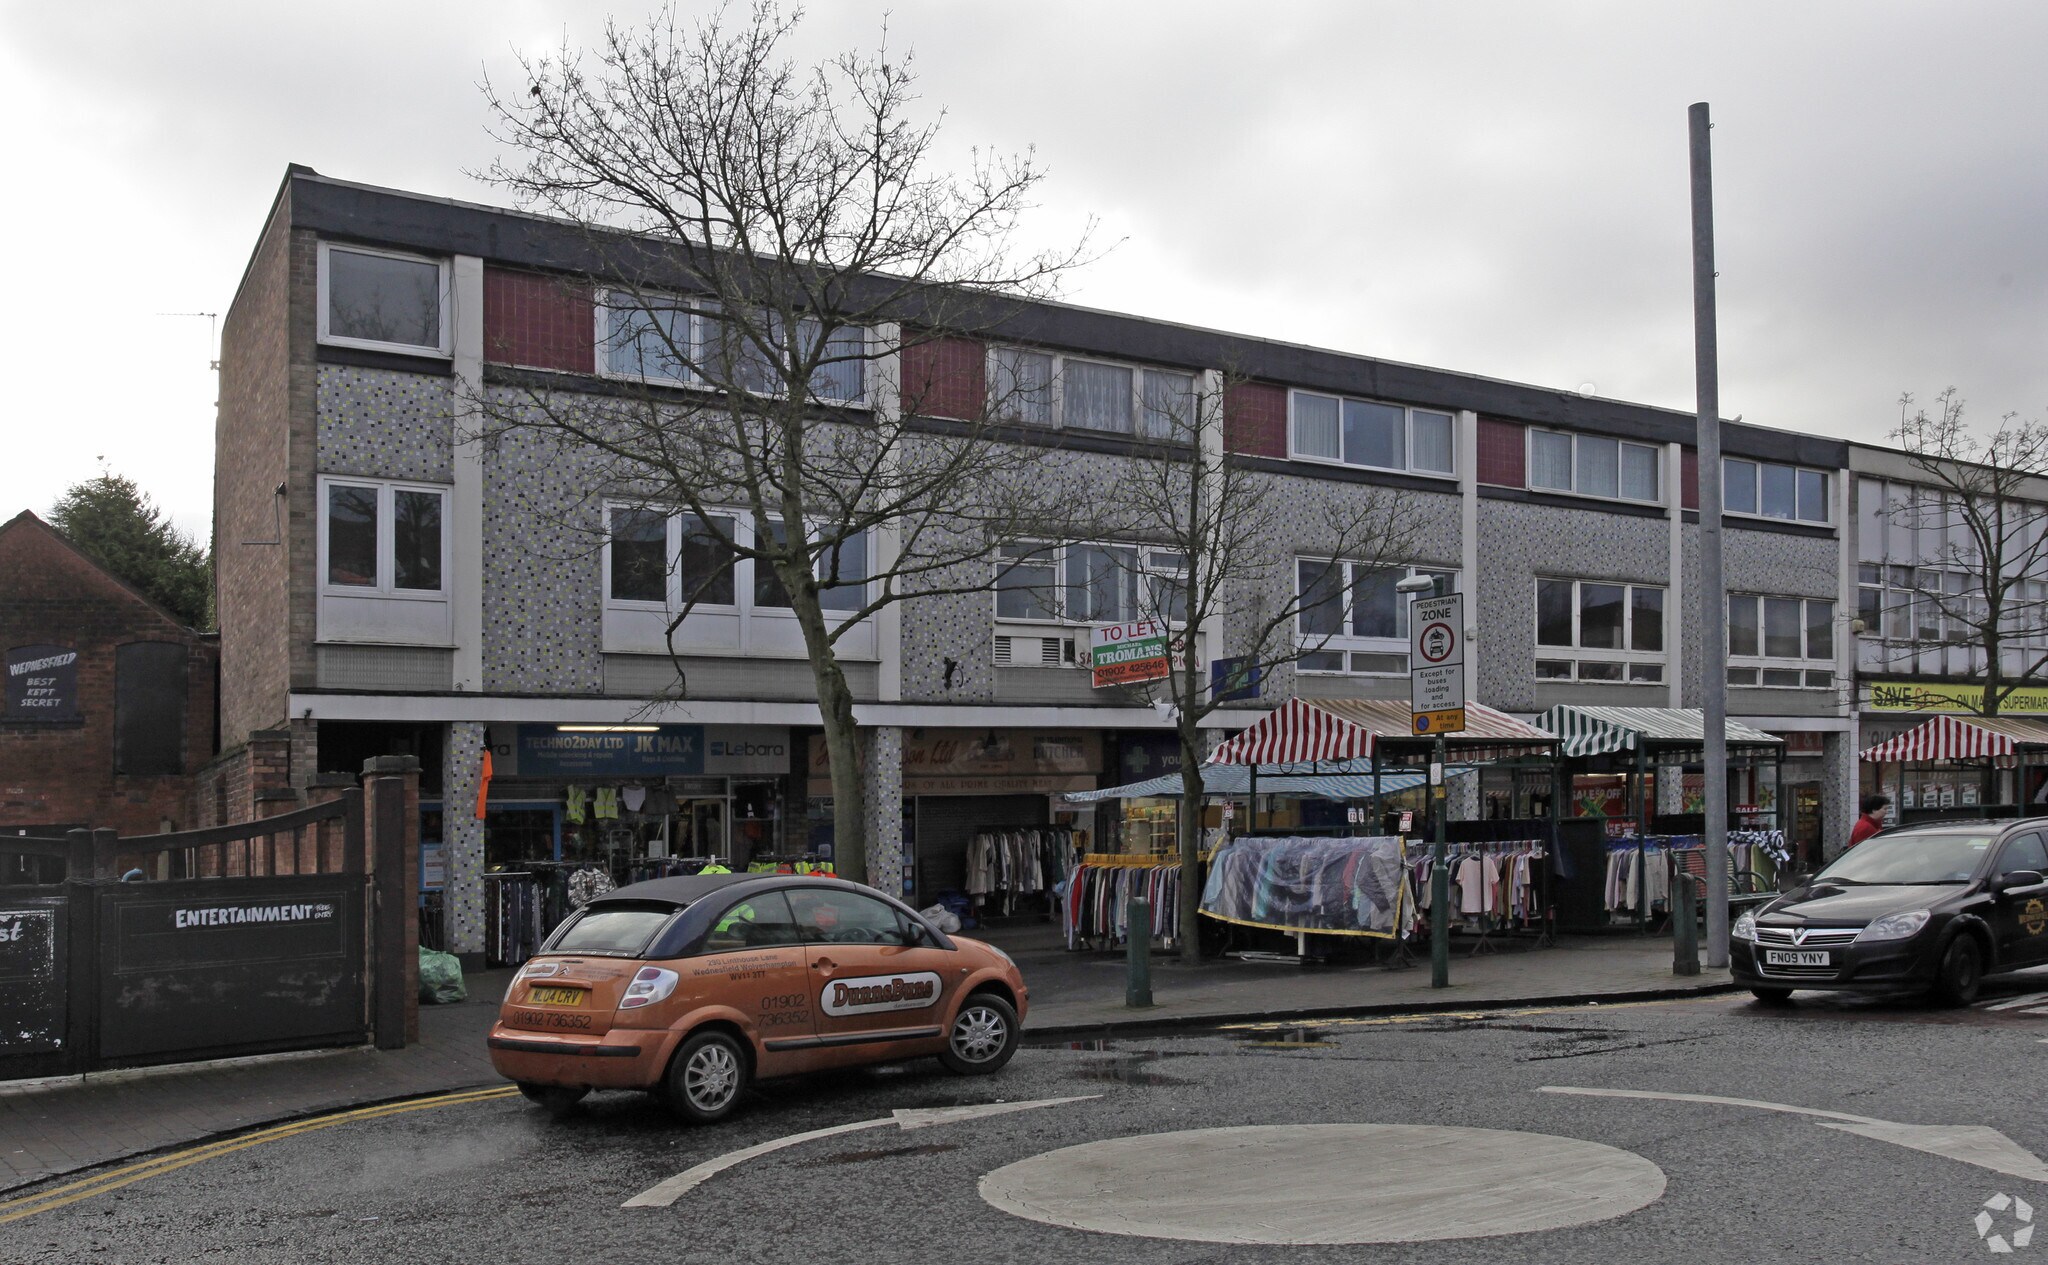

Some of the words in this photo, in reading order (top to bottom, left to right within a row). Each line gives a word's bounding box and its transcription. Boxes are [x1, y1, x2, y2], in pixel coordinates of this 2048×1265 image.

[1416, 598, 1457, 609] PEDESTRIAN
[1421, 608, 1451, 621] ZONE
[1101, 626, 1122, 641] TO
[1128, 620, 1157, 638] LET
[1116, 642, 1142, 650] MICHAEL
[1097, 644, 1163, 665] TROMANS
[9, 652, 77, 676] WEDNESFIELD
[1097, 666, 1126, 678] 01902
[1129, 660, 1164, 672] 425646
[26, 677, 57, 686] BEST
[1420, 670, 1443, 679] Except
[27, 688, 56, 696] KEPT
[1425, 685, 1449, 694] loading
[21, 698, 61, 707] SECRET
[1431, 693, 1444, 701] and
[1873, 685, 1911, 707] SAVE
[1957, 694, 1969, 709] ON
[1446, 714, 1458, 722] any
[1440, 722, 1454, 730] time
[525, 735, 602, 749] TECHNO2DAY
[604, 737, 624, 749] LTD
[634, 735, 654, 753] JK
[657, 735, 693, 753] MAX
[725, 741, 784, 756] Lebara
[175, 904, 313, 929] ENTERTAINMENT
[314, 910, 334, 920] ENTRY
[723, 955, 759, 965] Linthouse
[1770, 952, 1798, 963] FN09
[1801, 953, 1824, 963] YNY
[692, 965, 739, 976] Wednesfield
[740, 960, 797, 971] Wolverhampton
[557, 990, 580, 1004] CRV
[832, 978, 934, 1008] DunnsBuns
[762, 993, 805, 1010] 01902
[513, 1011, 544, 1026] 01902
[546, 1013, 592, 1029] 736352
[757, 1010, 809, 1027] 736352
